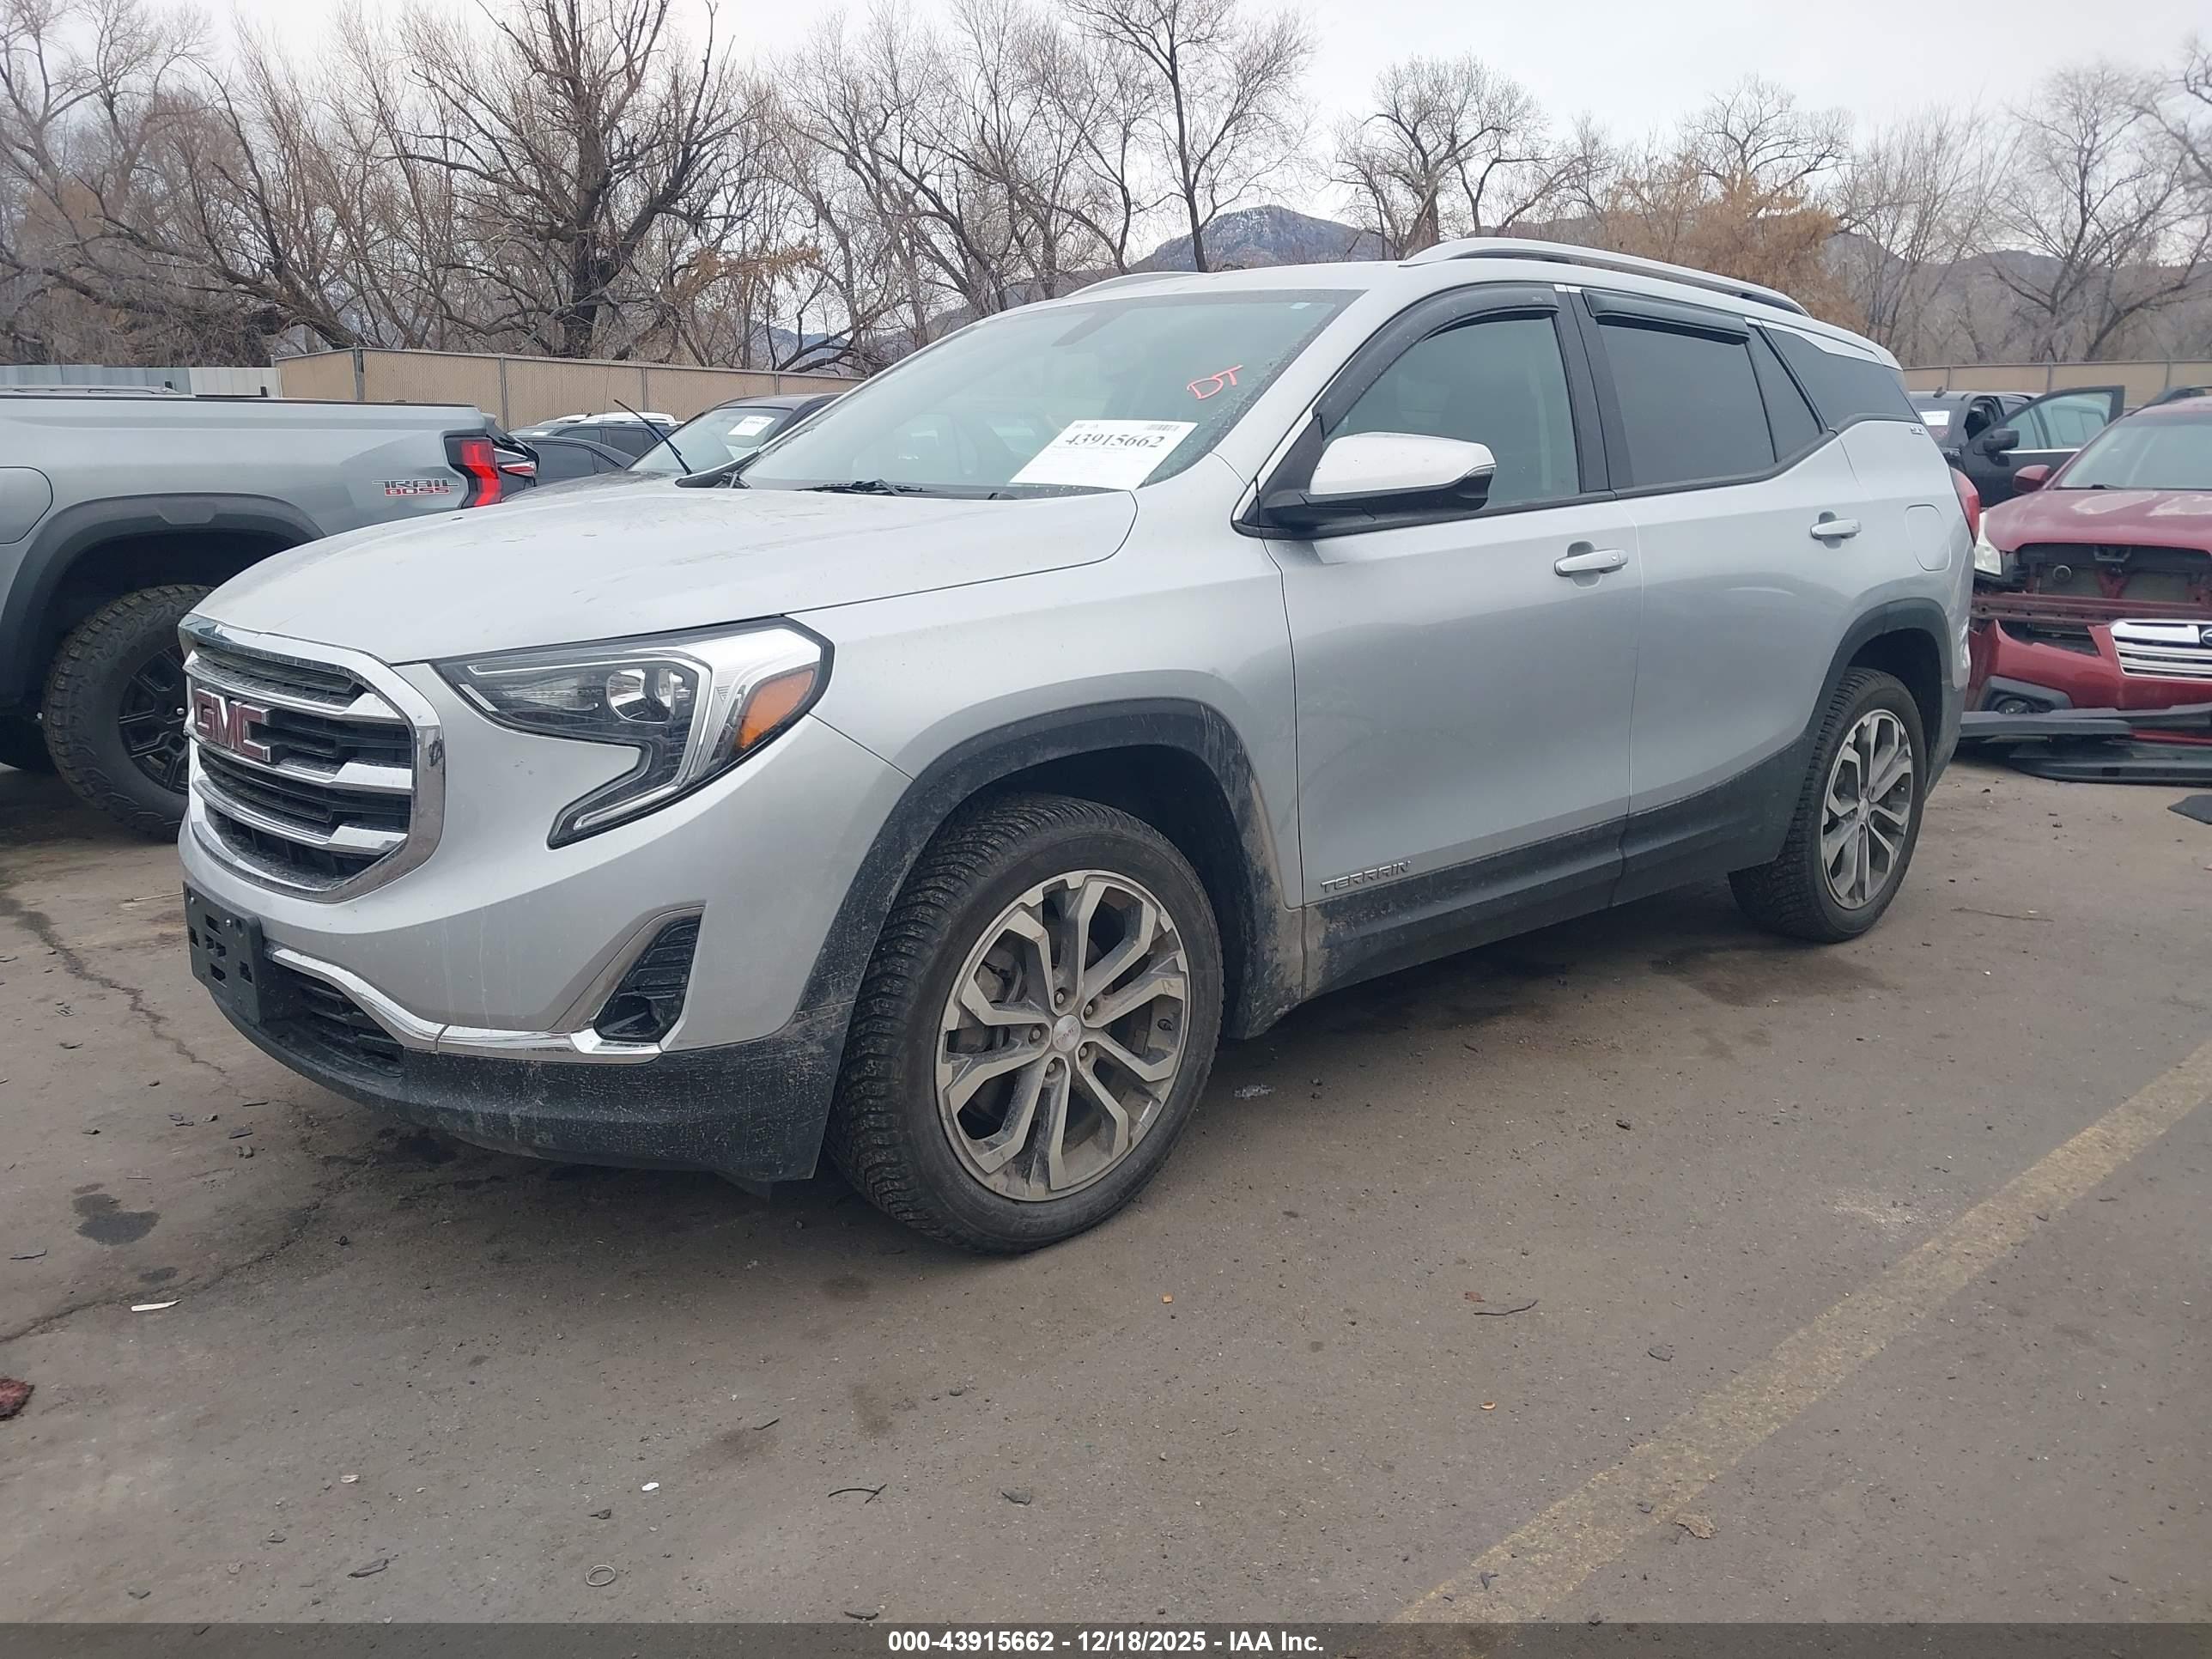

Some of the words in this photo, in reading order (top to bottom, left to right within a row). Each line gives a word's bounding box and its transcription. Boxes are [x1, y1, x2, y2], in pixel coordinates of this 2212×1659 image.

[1187, 364, 1243, 399] DT
[1066, 433, 1165, 448] 43915662
[372, 478, 460, 489] TRAIL
[384, 487, 450, 496] BOSS
[192, 688, 271, 763] GMC
[1321, 860, 1412, 893] TERRAIN
